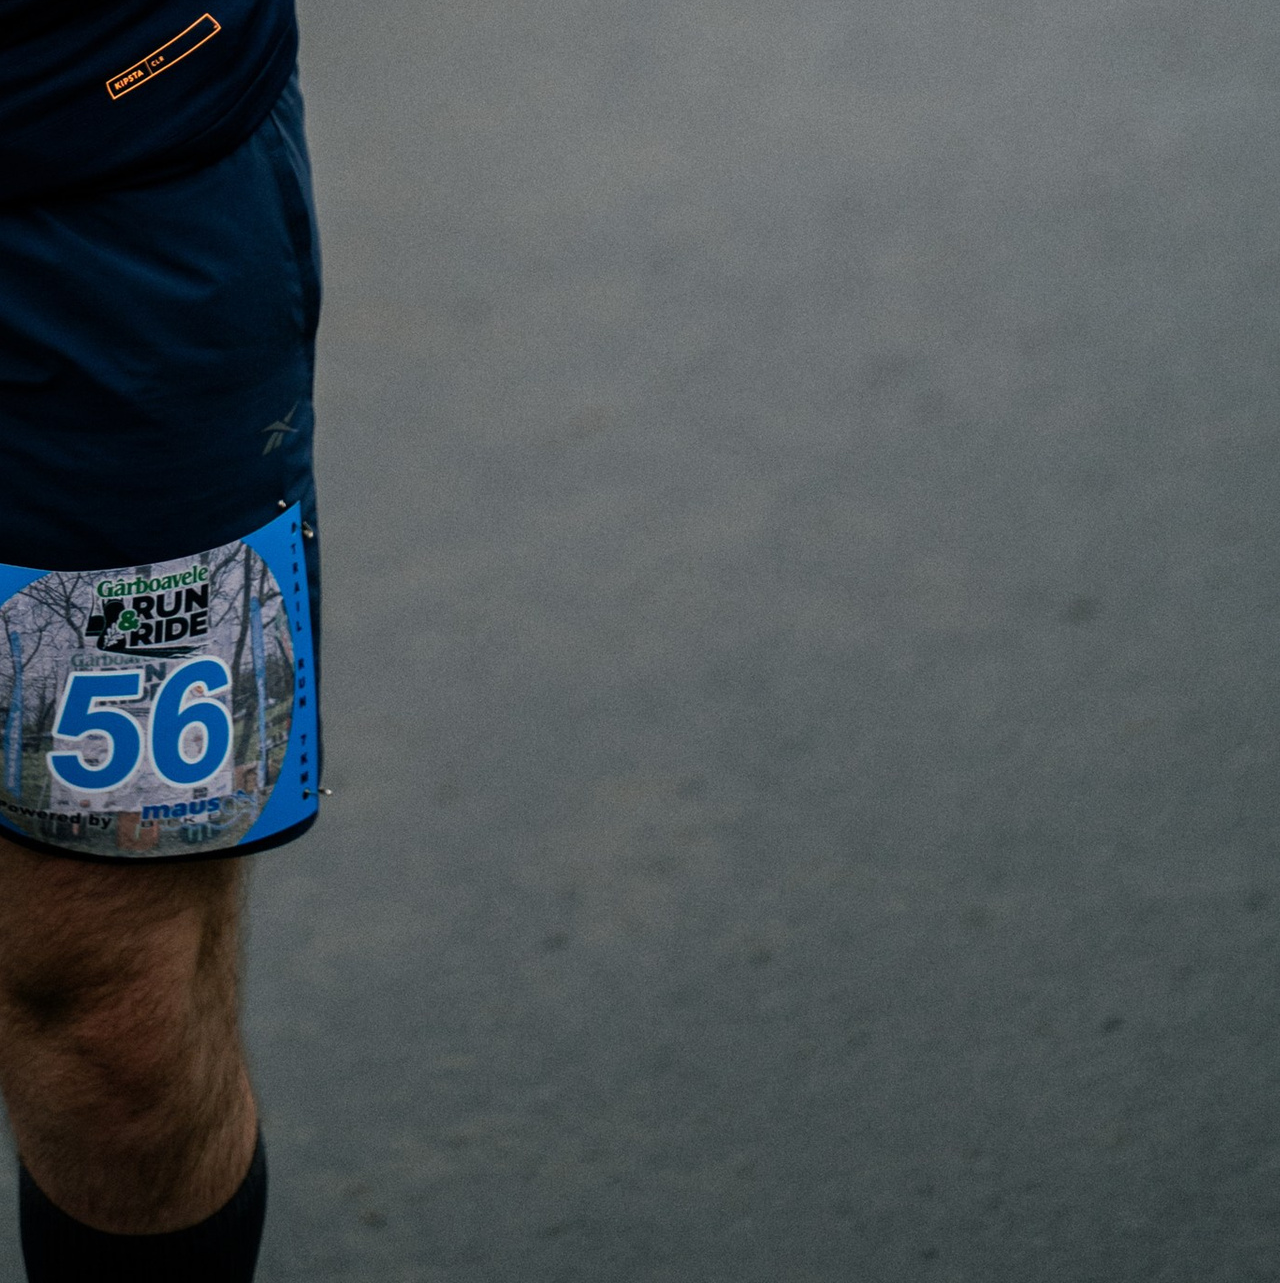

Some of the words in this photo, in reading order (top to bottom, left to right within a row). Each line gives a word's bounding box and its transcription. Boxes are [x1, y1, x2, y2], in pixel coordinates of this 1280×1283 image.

[113, 69, 144, 90] KIPSTA
[97, 565, 209, 598] Gârboavele
[132, 584, 209, 621] RUN
[118, 610, 140, 632] &
[130, 610, 209, 647] RIDE
[47, 655, 234, 794] 56
[88, 814, 113, 830] by
